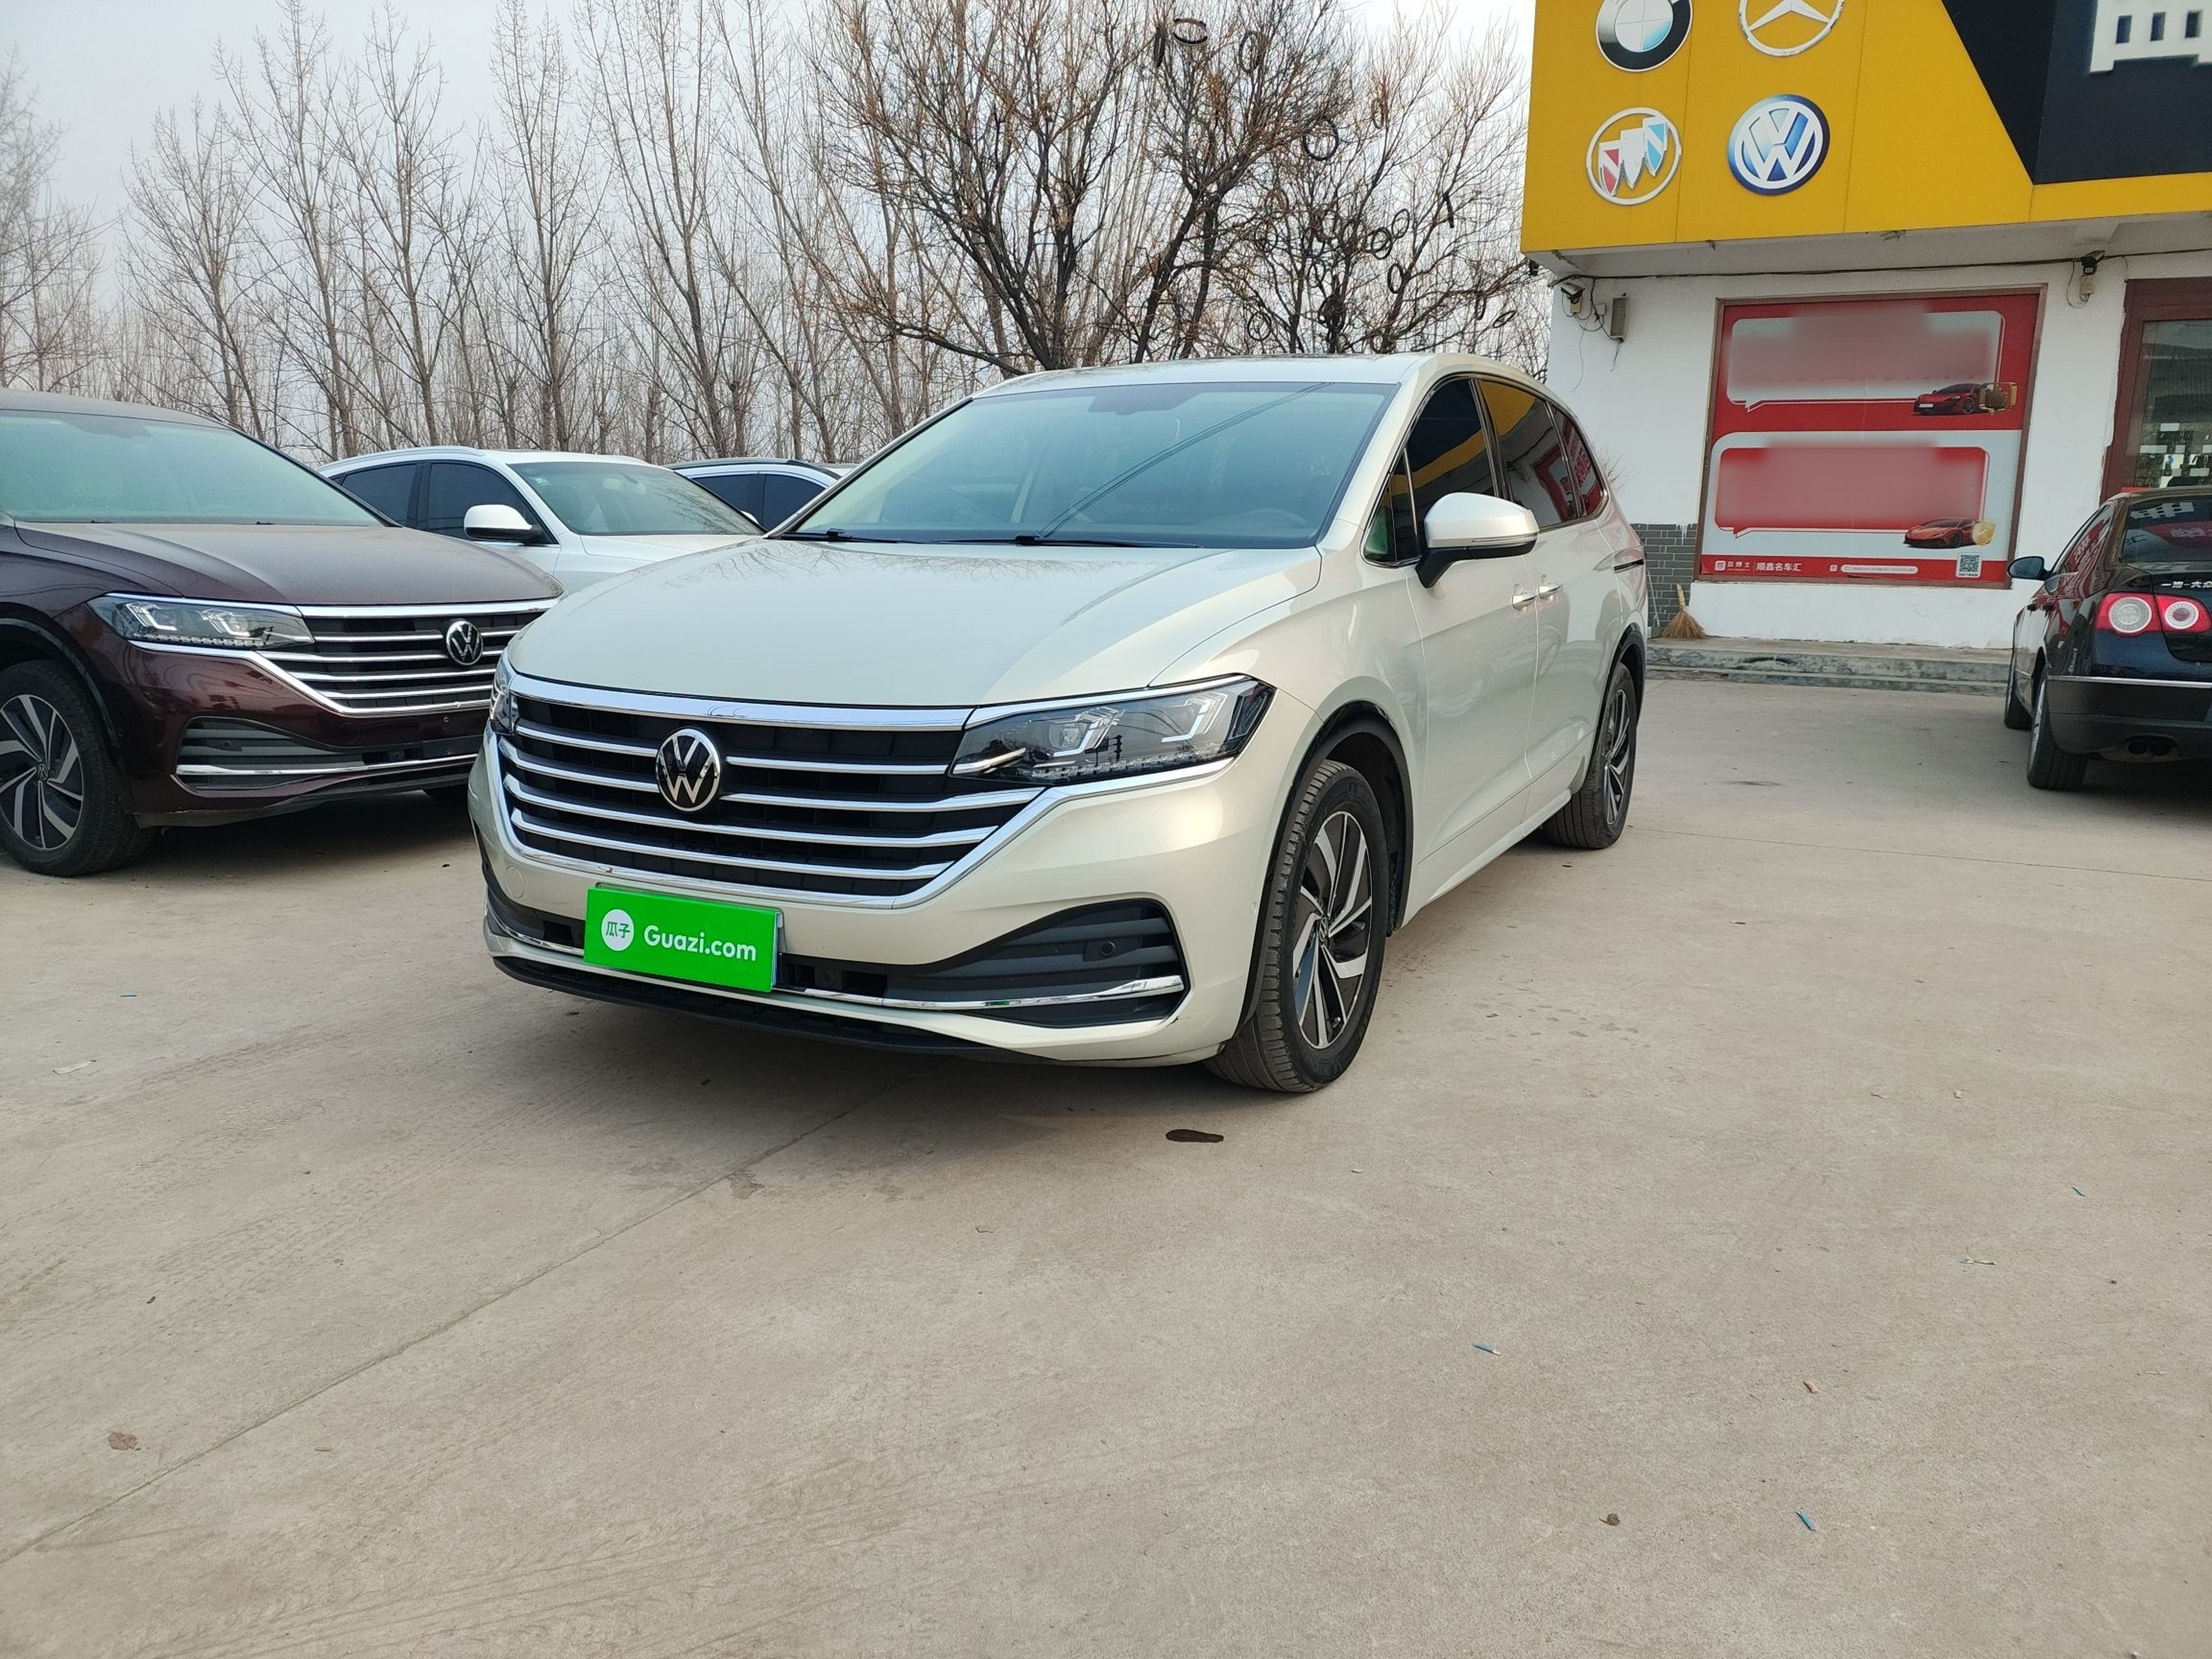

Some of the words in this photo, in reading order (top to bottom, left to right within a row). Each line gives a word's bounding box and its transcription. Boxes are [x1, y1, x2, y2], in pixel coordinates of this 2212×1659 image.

[1756, 562, 1802, 571] 顺鑫名车汇
[605, 922, 630, 938] 瓜子
[644, 925, 756, 961] Guazi.com
